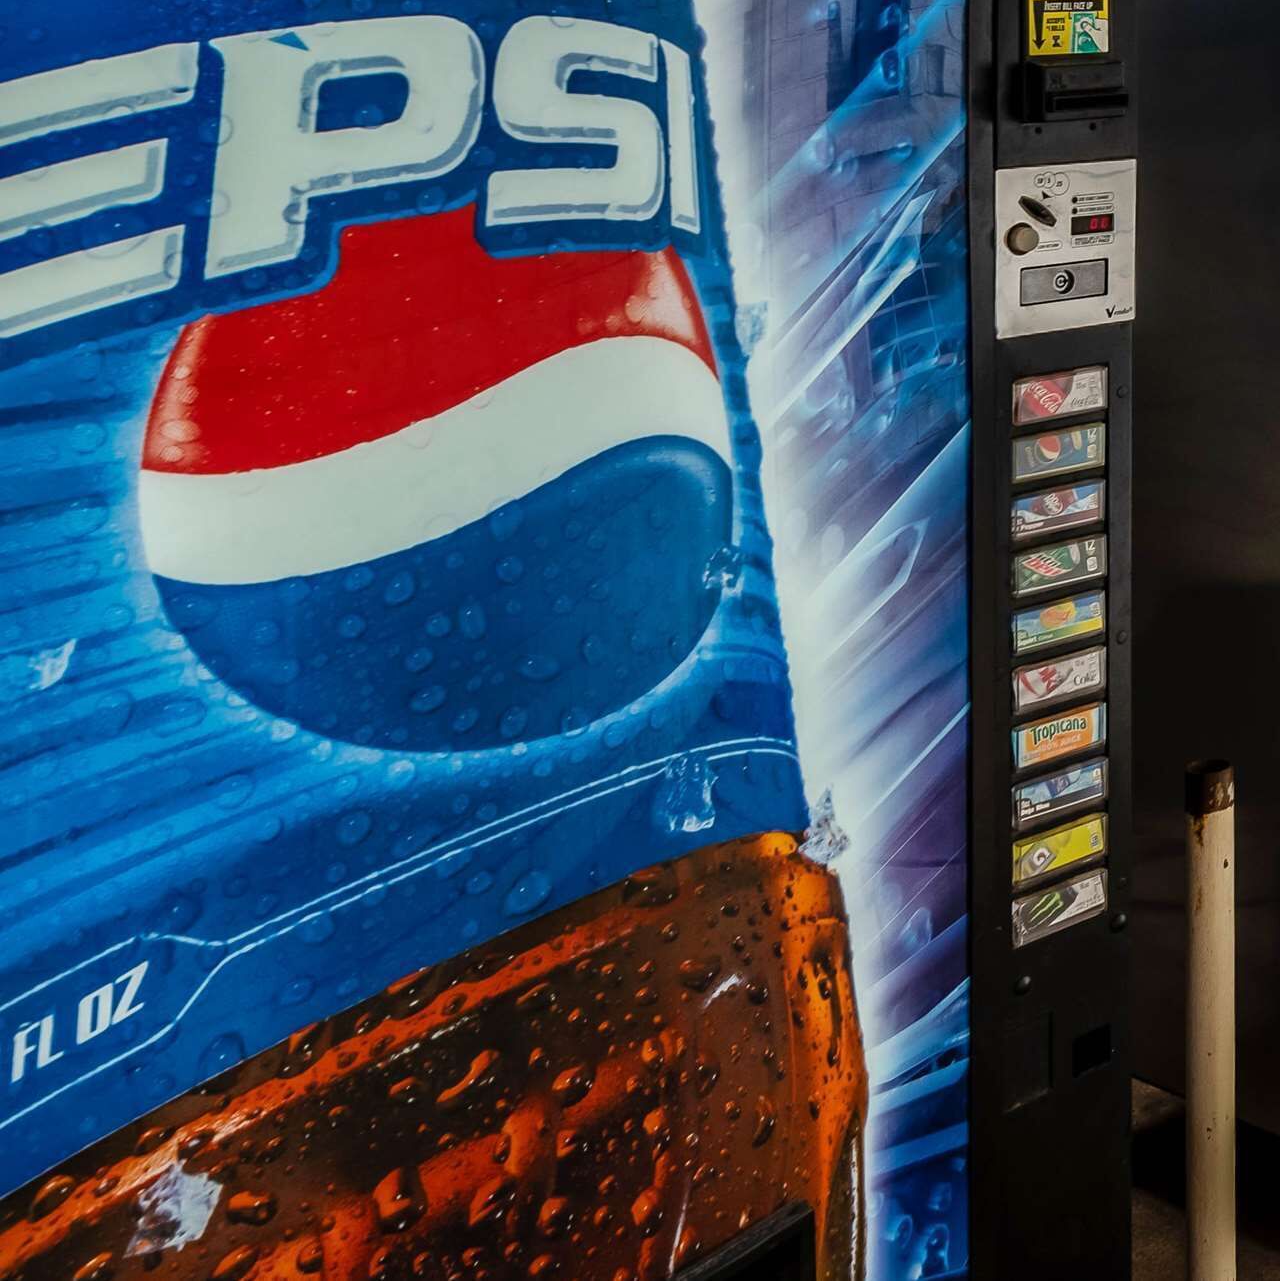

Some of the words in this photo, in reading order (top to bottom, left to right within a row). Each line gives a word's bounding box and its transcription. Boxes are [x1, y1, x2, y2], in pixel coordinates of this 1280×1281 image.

[1062, 2, 1072, 11] BILL
[1073, 1, 1085, 10] FACE
[1086, 1, 1094, 10] UP
[1030, 717, 1087, 745] Tropicana
[11, 1014, 64, 1083] FL
[76, 960, 149, 1045] OZ
